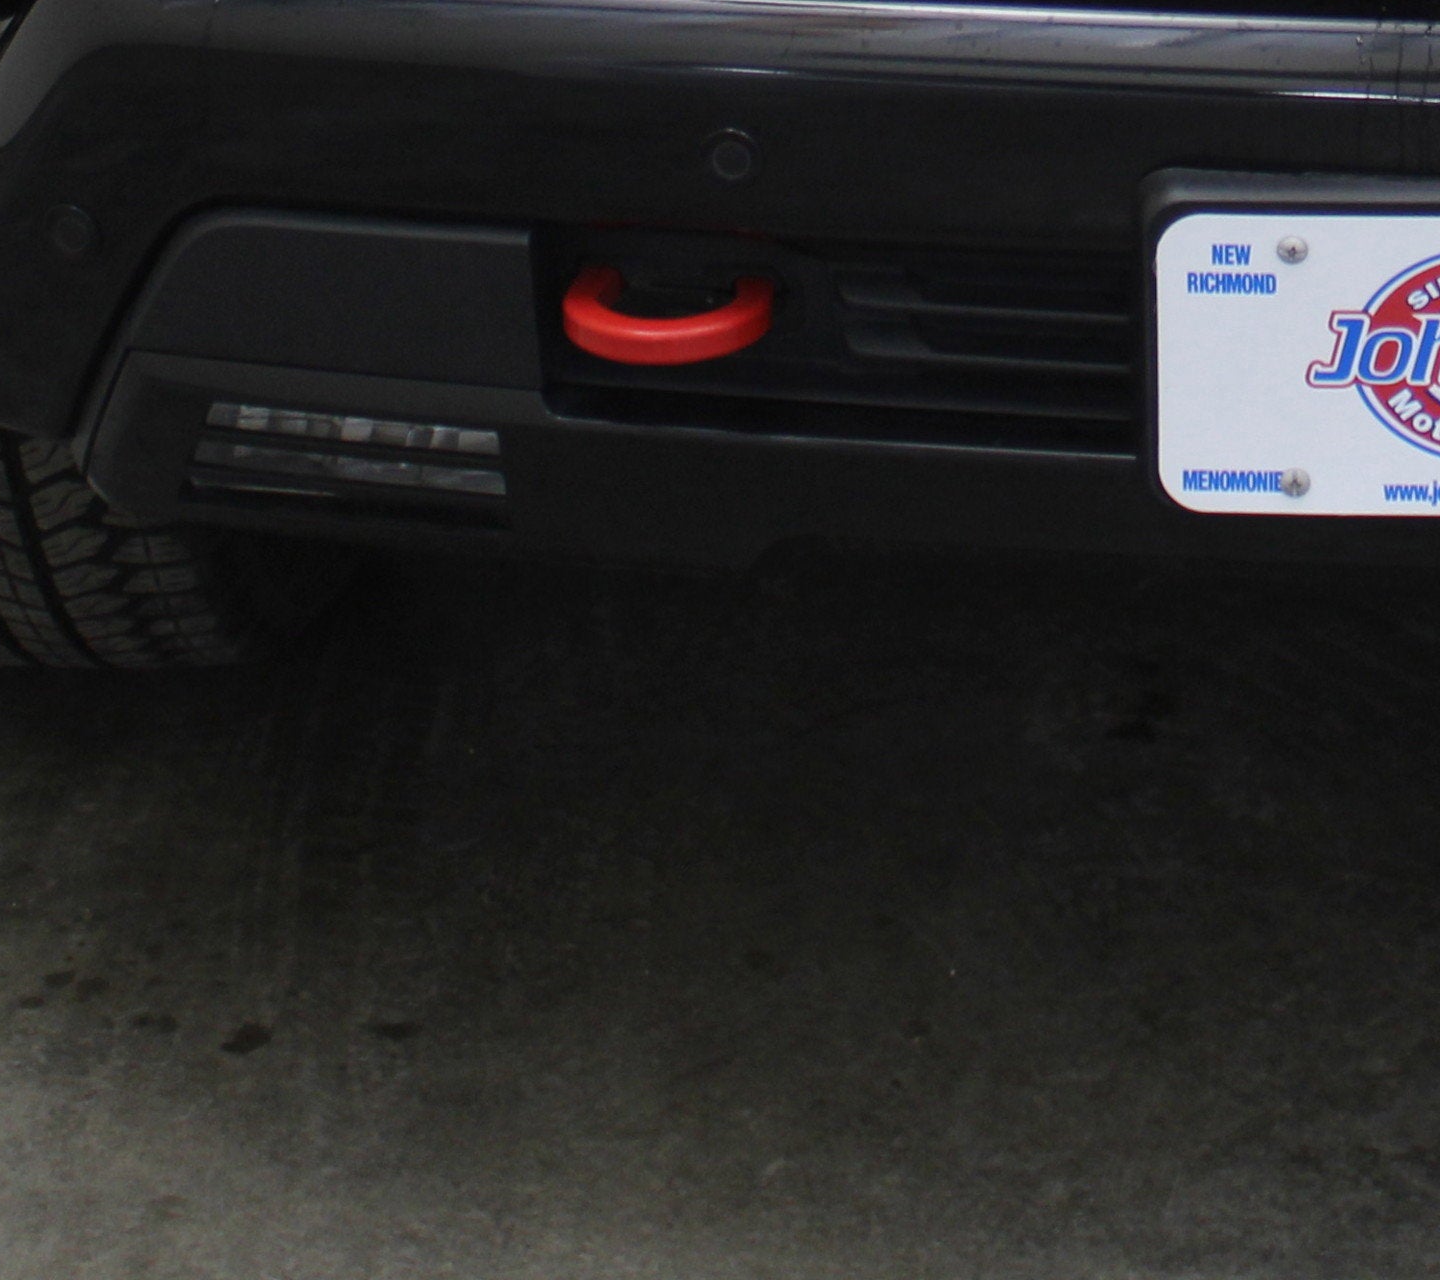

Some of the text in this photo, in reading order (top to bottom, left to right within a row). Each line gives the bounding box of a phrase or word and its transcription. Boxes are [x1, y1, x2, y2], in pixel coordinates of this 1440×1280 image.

[1211, 244, 1251, 266] NEW
[1186, 272, 1278, 295] RICHMOND
[1181, 469, 1284, 493] MENOMONIE
